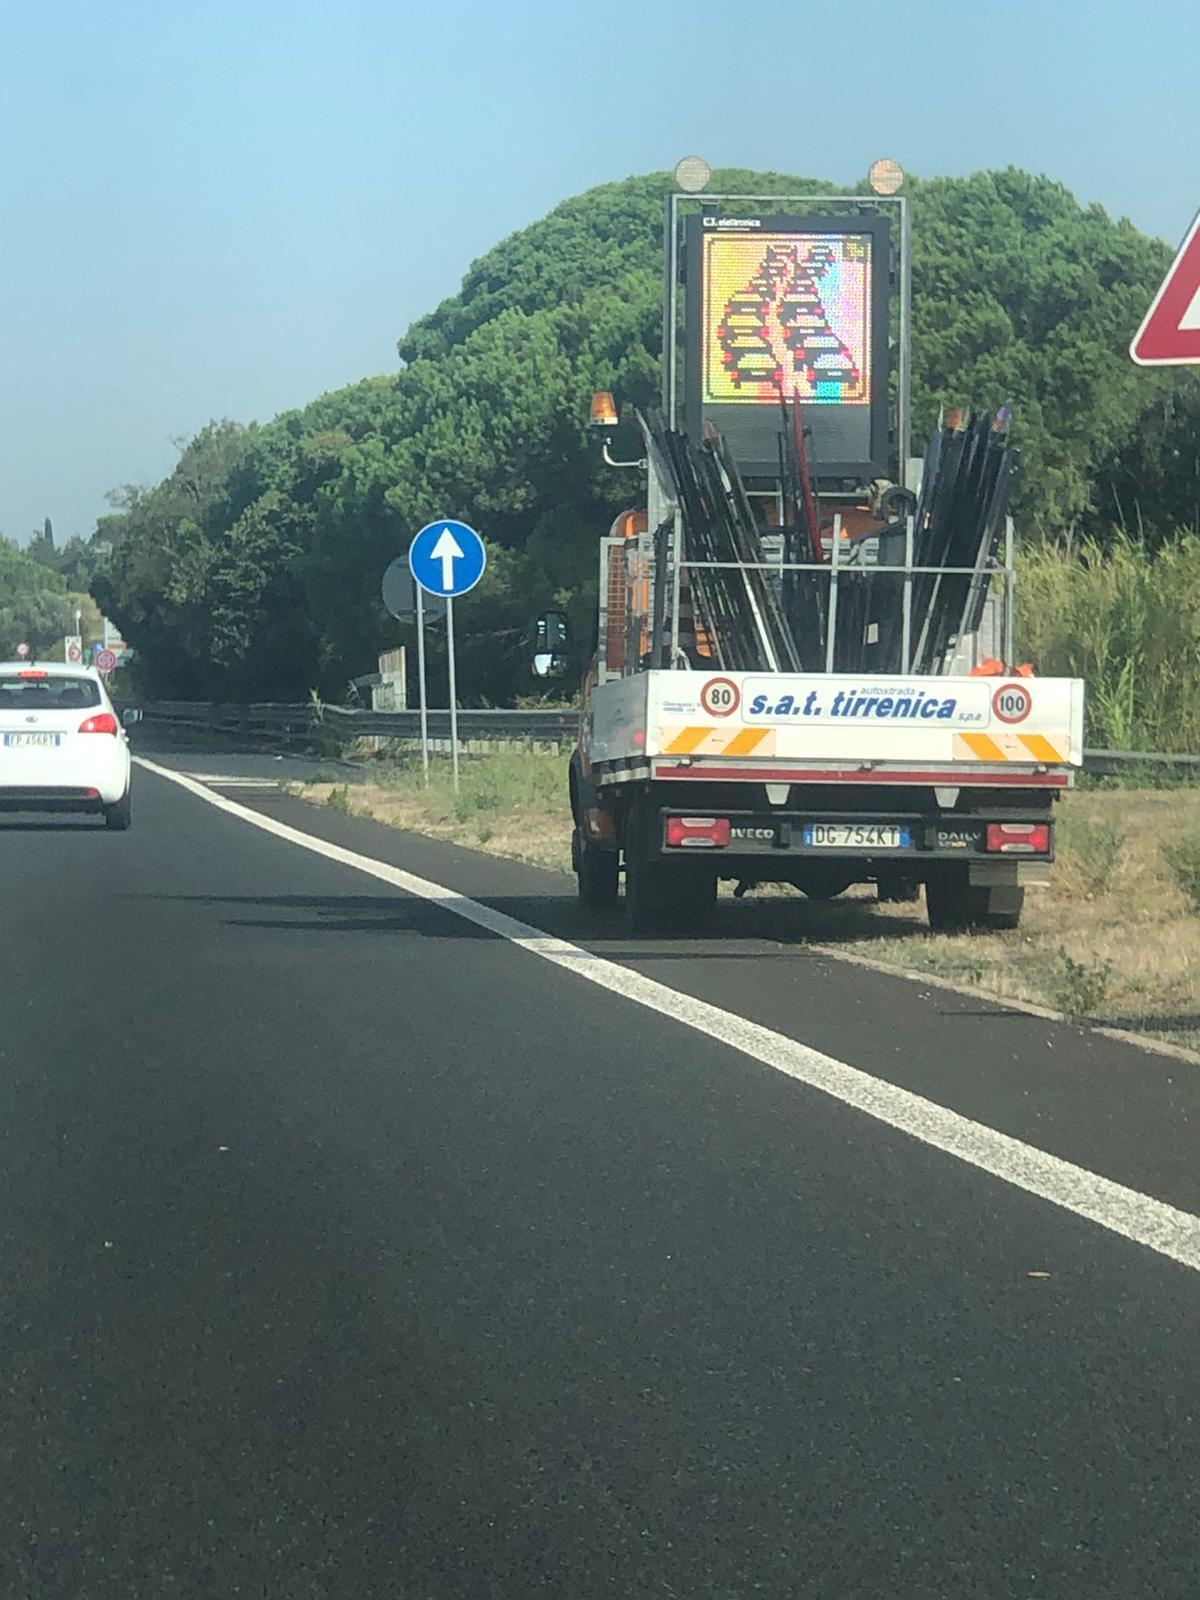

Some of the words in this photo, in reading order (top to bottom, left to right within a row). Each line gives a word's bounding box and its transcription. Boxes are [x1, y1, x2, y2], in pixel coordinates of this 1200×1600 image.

[711, 688, 731, 705] 80
[860, 687, 916, 696] autostrada
[749, 691, 823, 716] s.a.t.
[830, 689, 957, 719] tirrenica
[998, 695, 1025, 713] 100
[731, 828, 775, 839] IVECO
[815, 825, 837, 844] DG
[844, 826, 898, 845] 754KT
